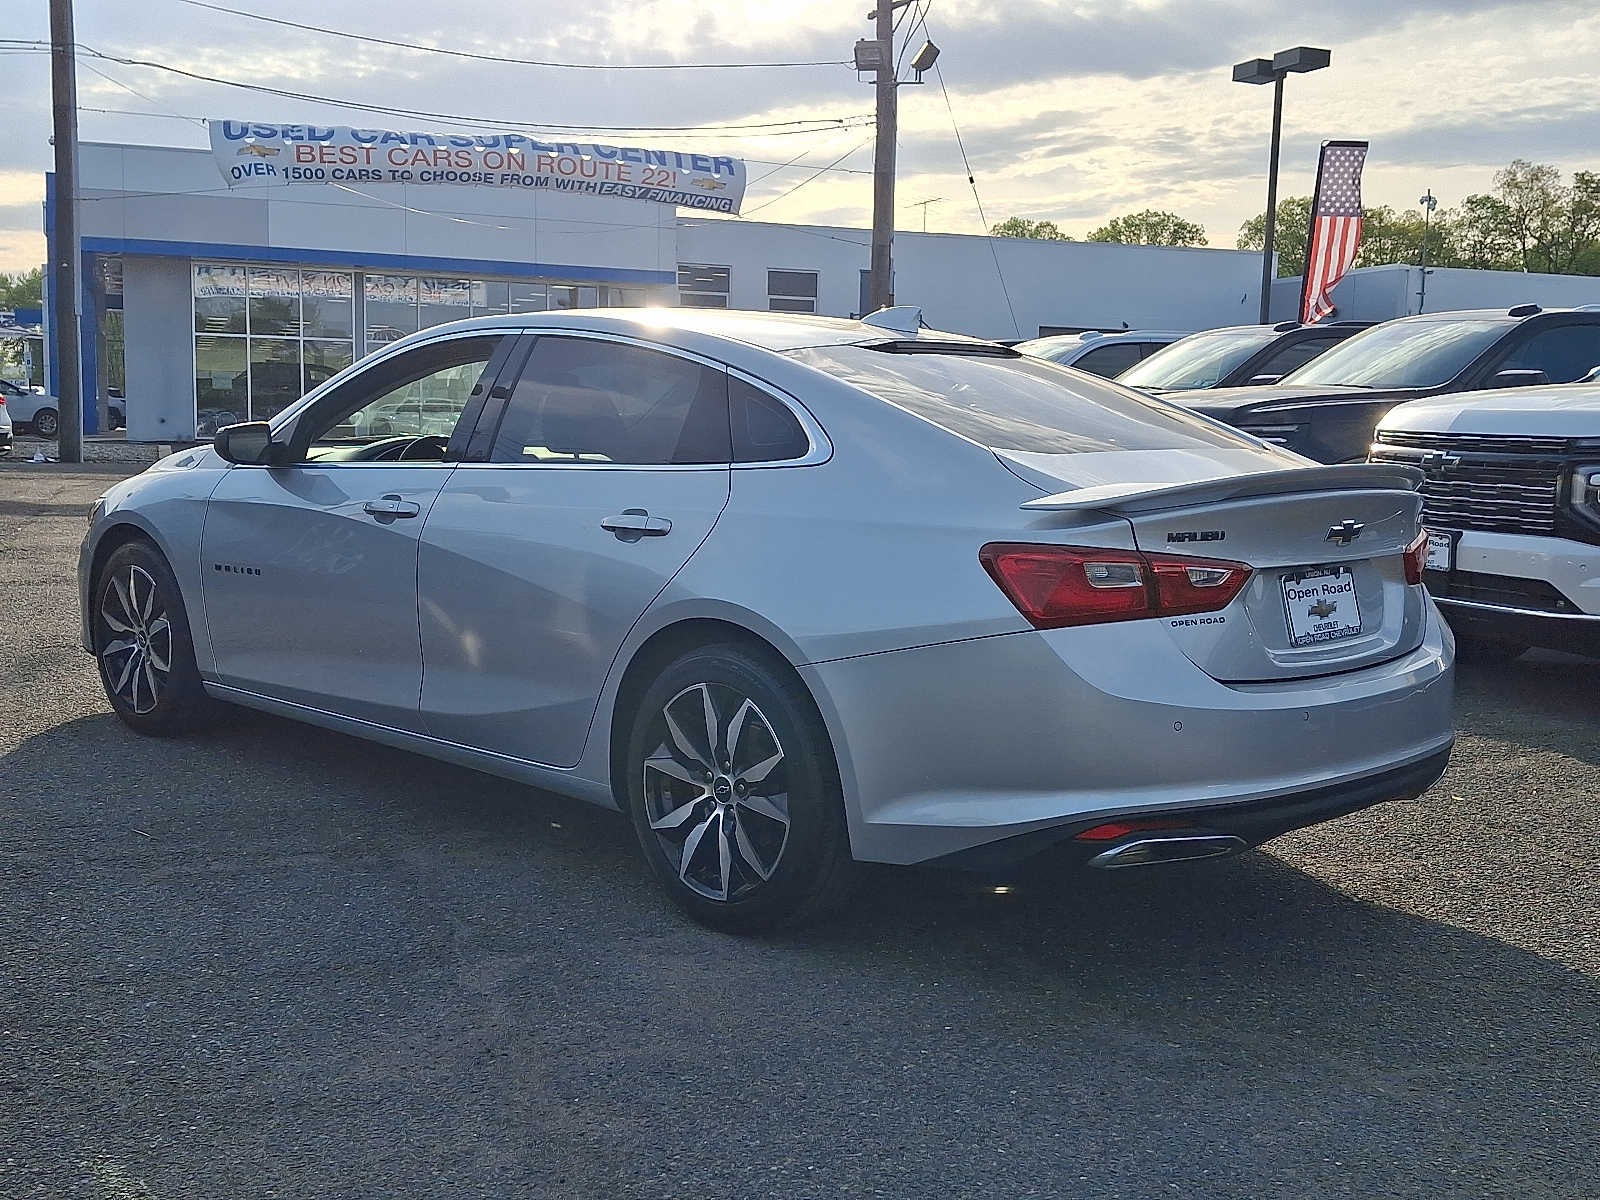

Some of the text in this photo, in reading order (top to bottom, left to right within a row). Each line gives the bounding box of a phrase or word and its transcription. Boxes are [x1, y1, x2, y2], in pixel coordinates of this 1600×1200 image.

[222, 120, 335, 141] USED
[350, 128, 436, 146] CAR
[592, 144, 735, 176] CENTER
[295, 144, 677, 189] BEST CARS ON ROUTE 22!
[231, 162, 732, 211] OVER 1500 CARS TO CHOOSE FROM WITH EASY FINANCING
[1166, 530, 1226, 543] MALIBU
[1287, 581, 1351, 601] Open Road
[1170, 616, 1226, 627] OPEN ROAD
